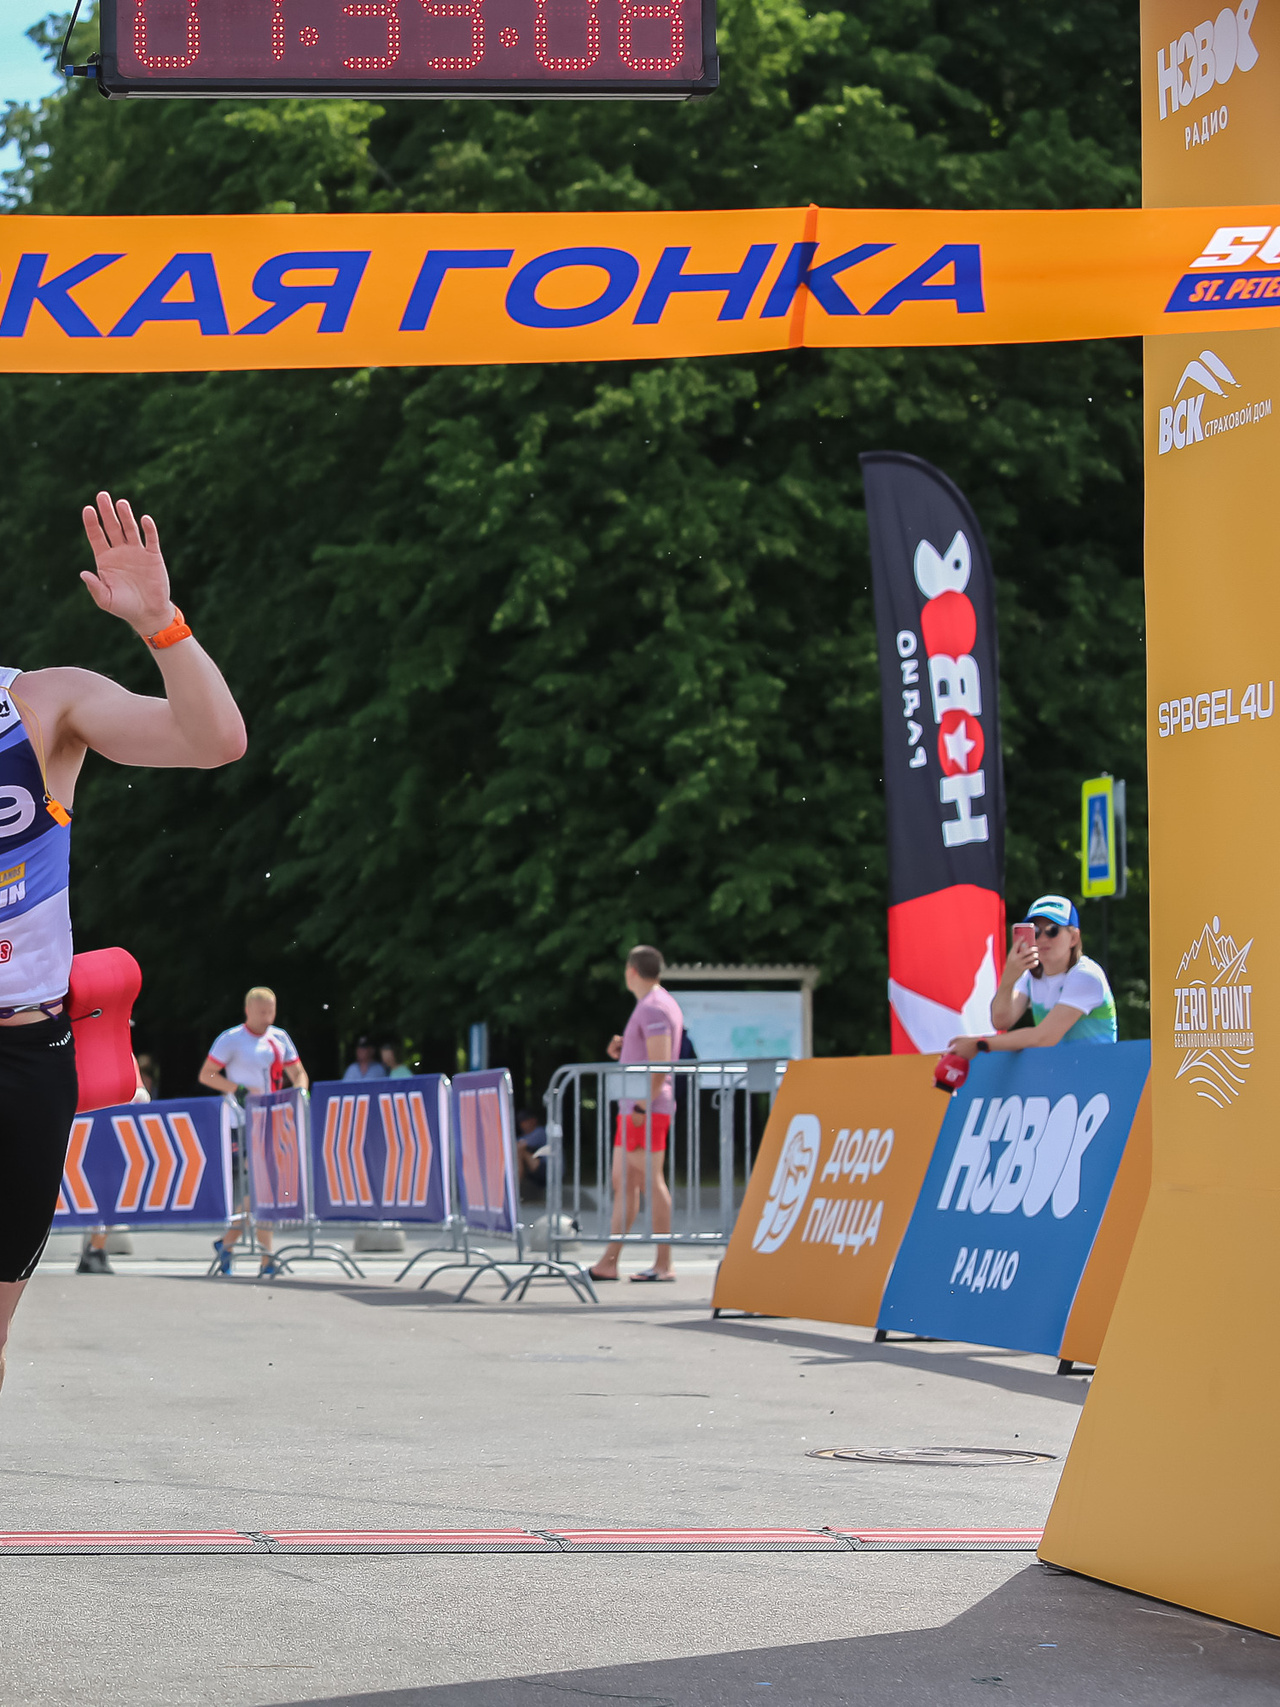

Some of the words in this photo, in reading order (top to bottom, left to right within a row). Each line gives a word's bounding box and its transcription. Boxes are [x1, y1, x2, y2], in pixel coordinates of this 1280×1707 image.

[1185, 105, 1228, 150] РАДИО
[398, 242, 986, 332] ГОНКА
[1188, 279, 1224, 302] ST.
[1158, 393, 1205, 455] ВСК
[1204, 402, 1252, 437] СТРАХОВОЙ
[1252, 398, 1272, 424] ДОМ
[1174, 987, 1207, 1031] ZERO
[1211, 985, 1252, 1030] POINT
[820, 1128, 894, 1184] ДОДО
[801, 1197, 885, 1255] ПИЦЦА
[949, 1247, 1020, 1293] РАДИО
